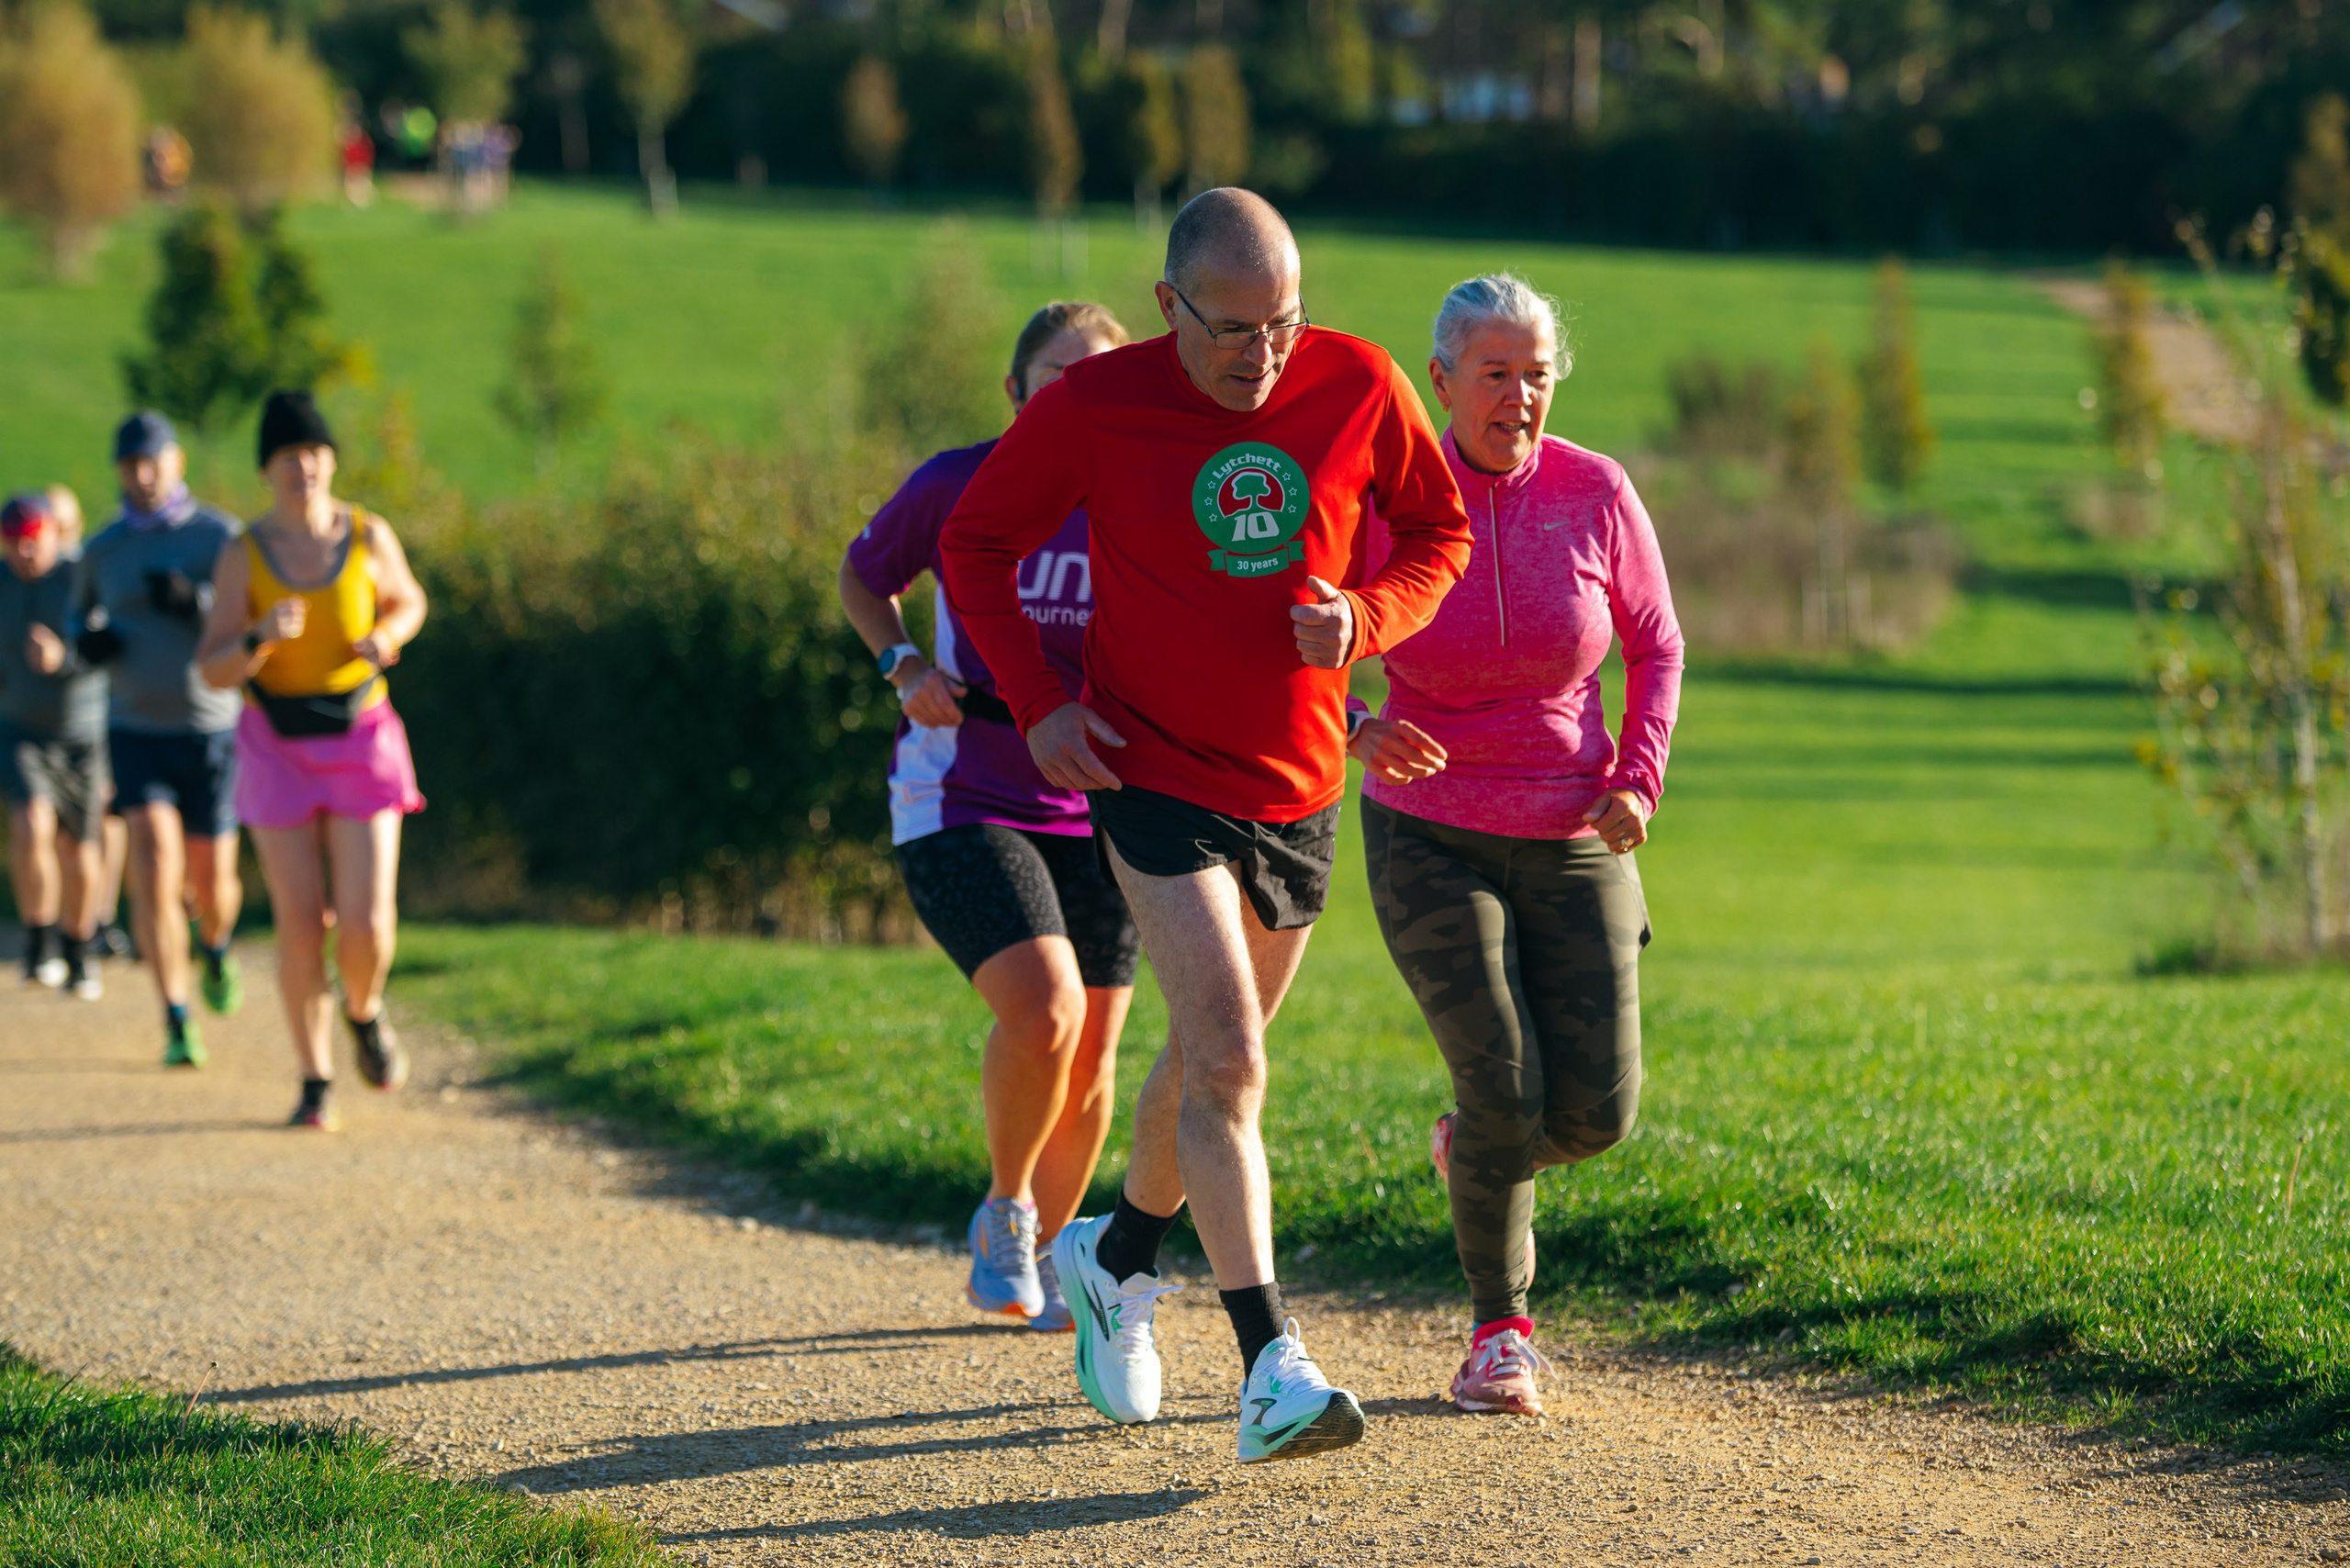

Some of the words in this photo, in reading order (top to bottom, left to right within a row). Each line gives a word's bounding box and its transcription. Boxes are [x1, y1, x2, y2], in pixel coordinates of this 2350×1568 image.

[1213, 453, 1282, 480] Lytchett
[1231, 511, 1280, 543] 10
[1237, 560, 1249, 571] 30
[1250, 557, 1279, 573] years
